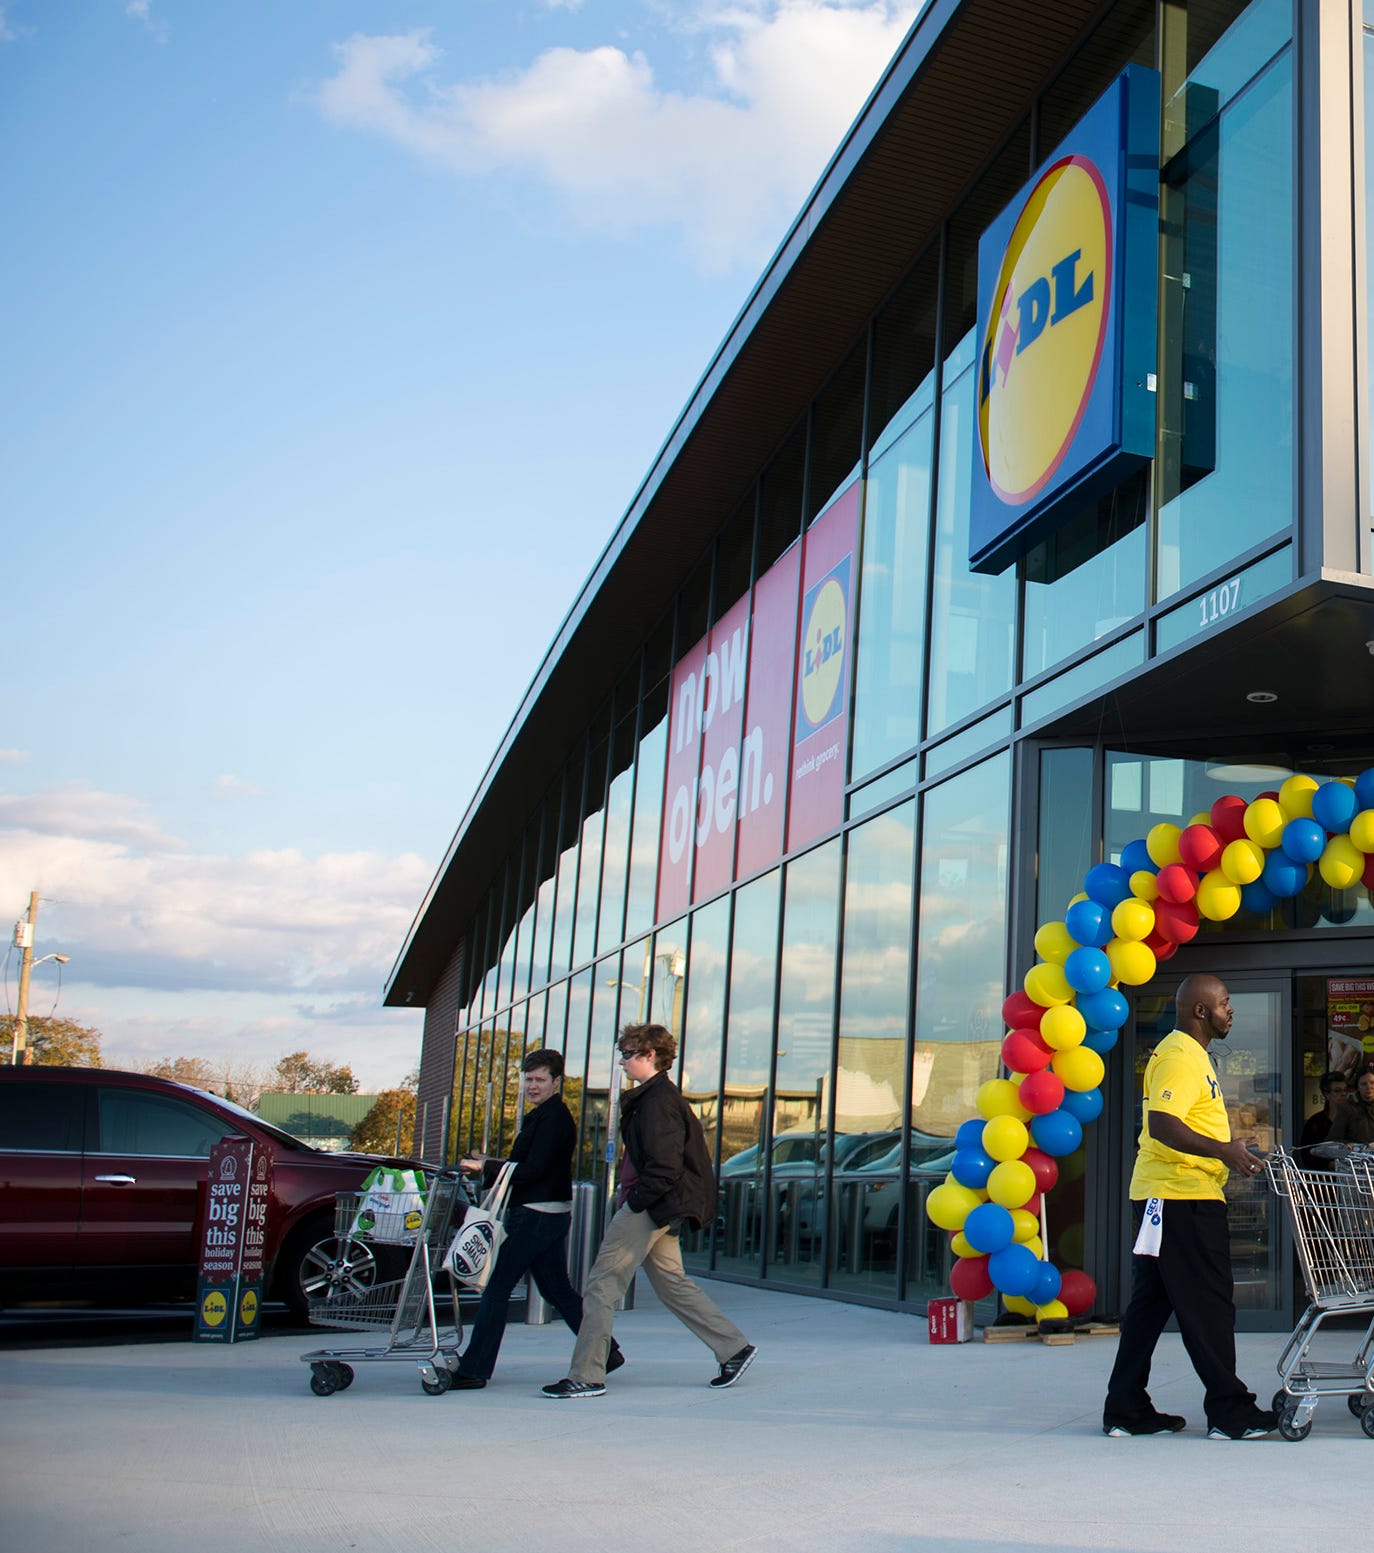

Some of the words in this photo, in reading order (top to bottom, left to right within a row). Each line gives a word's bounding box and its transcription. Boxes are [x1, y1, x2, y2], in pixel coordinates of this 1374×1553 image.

[1199, 577, 1241, 627] 1107
[676, 613, 753, 755] now
[669, 725, 773, 886] open.
[210, 1183, 240, 1196] save
[250, 1183, 268, 1196] save
[209, 1198, 239, 1226] big
[249, 1198, 267, 1225] big
[206, 1226, 236, 1245] this
[245, 1226, 264, 1245] this
[470, 1234, 487, 1256] SHOP
[205, 1247, 235, 1259] holiday
[244, 1246, 263, 1257] holiday
[462, 1241, 481, 1268] SMALL
[203, 1261, 233, 1270] season
[242, 1260, 262, 1270] season
